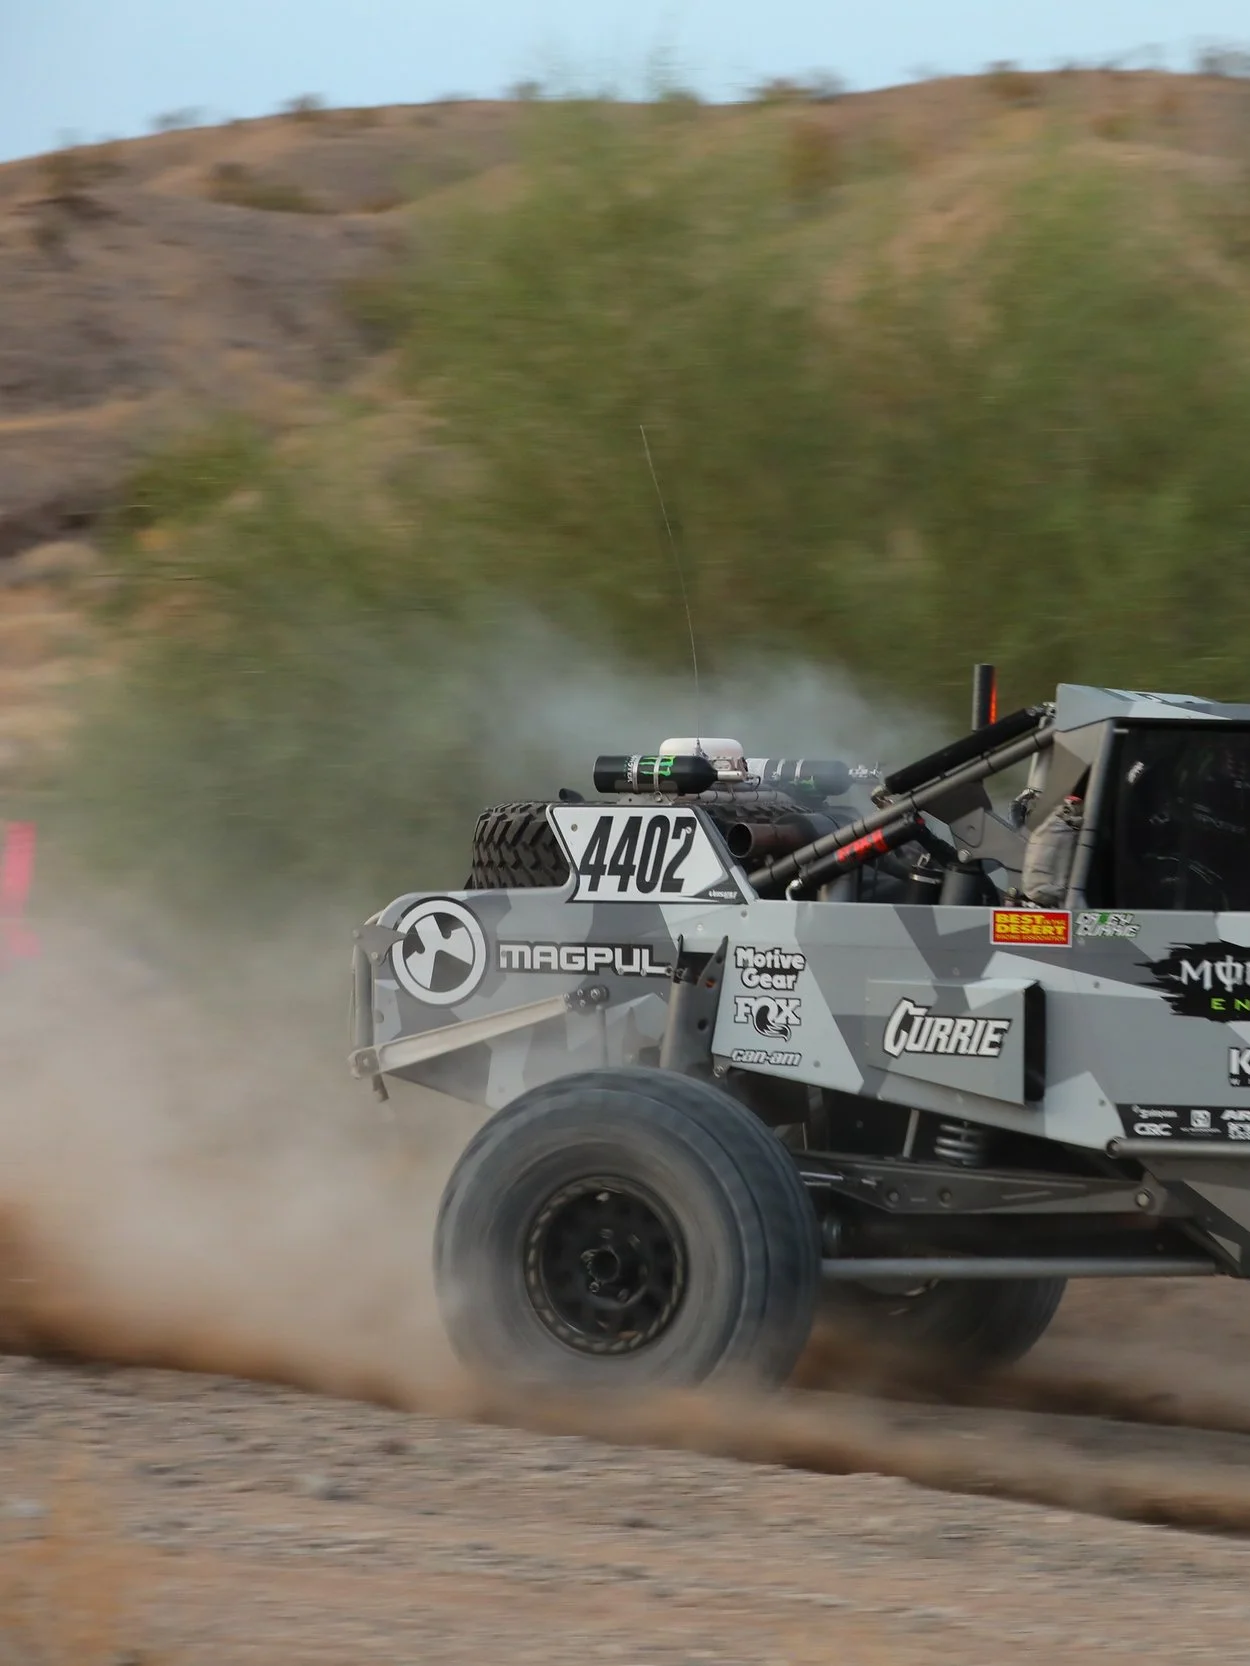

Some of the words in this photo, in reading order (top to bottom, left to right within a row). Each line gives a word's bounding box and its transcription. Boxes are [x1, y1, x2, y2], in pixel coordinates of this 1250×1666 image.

[579, 814, 697, 894] 4402
[995, 912, 1045, 925] BEST
[995, 923, 1066, 936] DESERT
[500, 944, 673, 976] MAGPUL
[736, 946, 805, 970] Motive
[742, 967, 797, 990] Gear
[734, 996, 801, 1038] FOX
[883, 998, 1011, 1058] CURRIE
